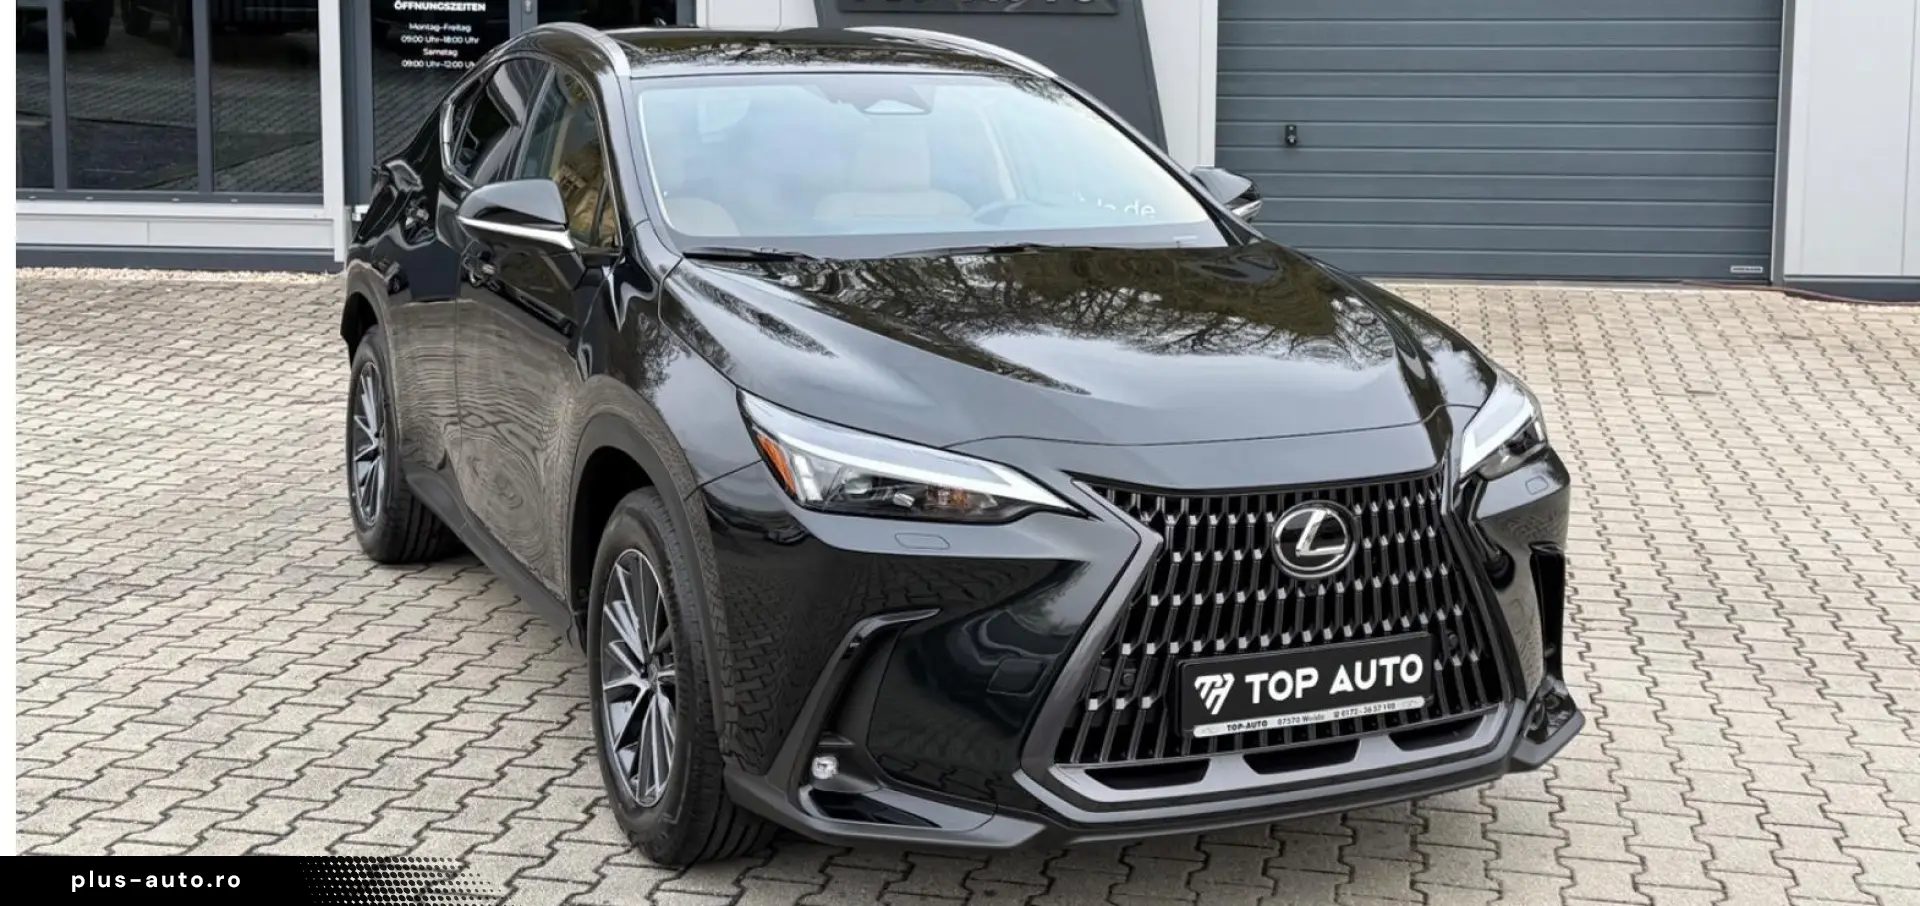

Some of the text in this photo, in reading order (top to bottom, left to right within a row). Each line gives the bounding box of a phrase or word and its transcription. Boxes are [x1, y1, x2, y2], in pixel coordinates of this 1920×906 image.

[394, 0, 486, 12] ÖFFNUNGSZEITEN
[423, 48, 458, 58] Samstag
[1245, 667, 1319, 704] TOP
[1329, 653, 1424, 694] AUTO
[1227, 719, 1269, 733] TOP-AUTO
